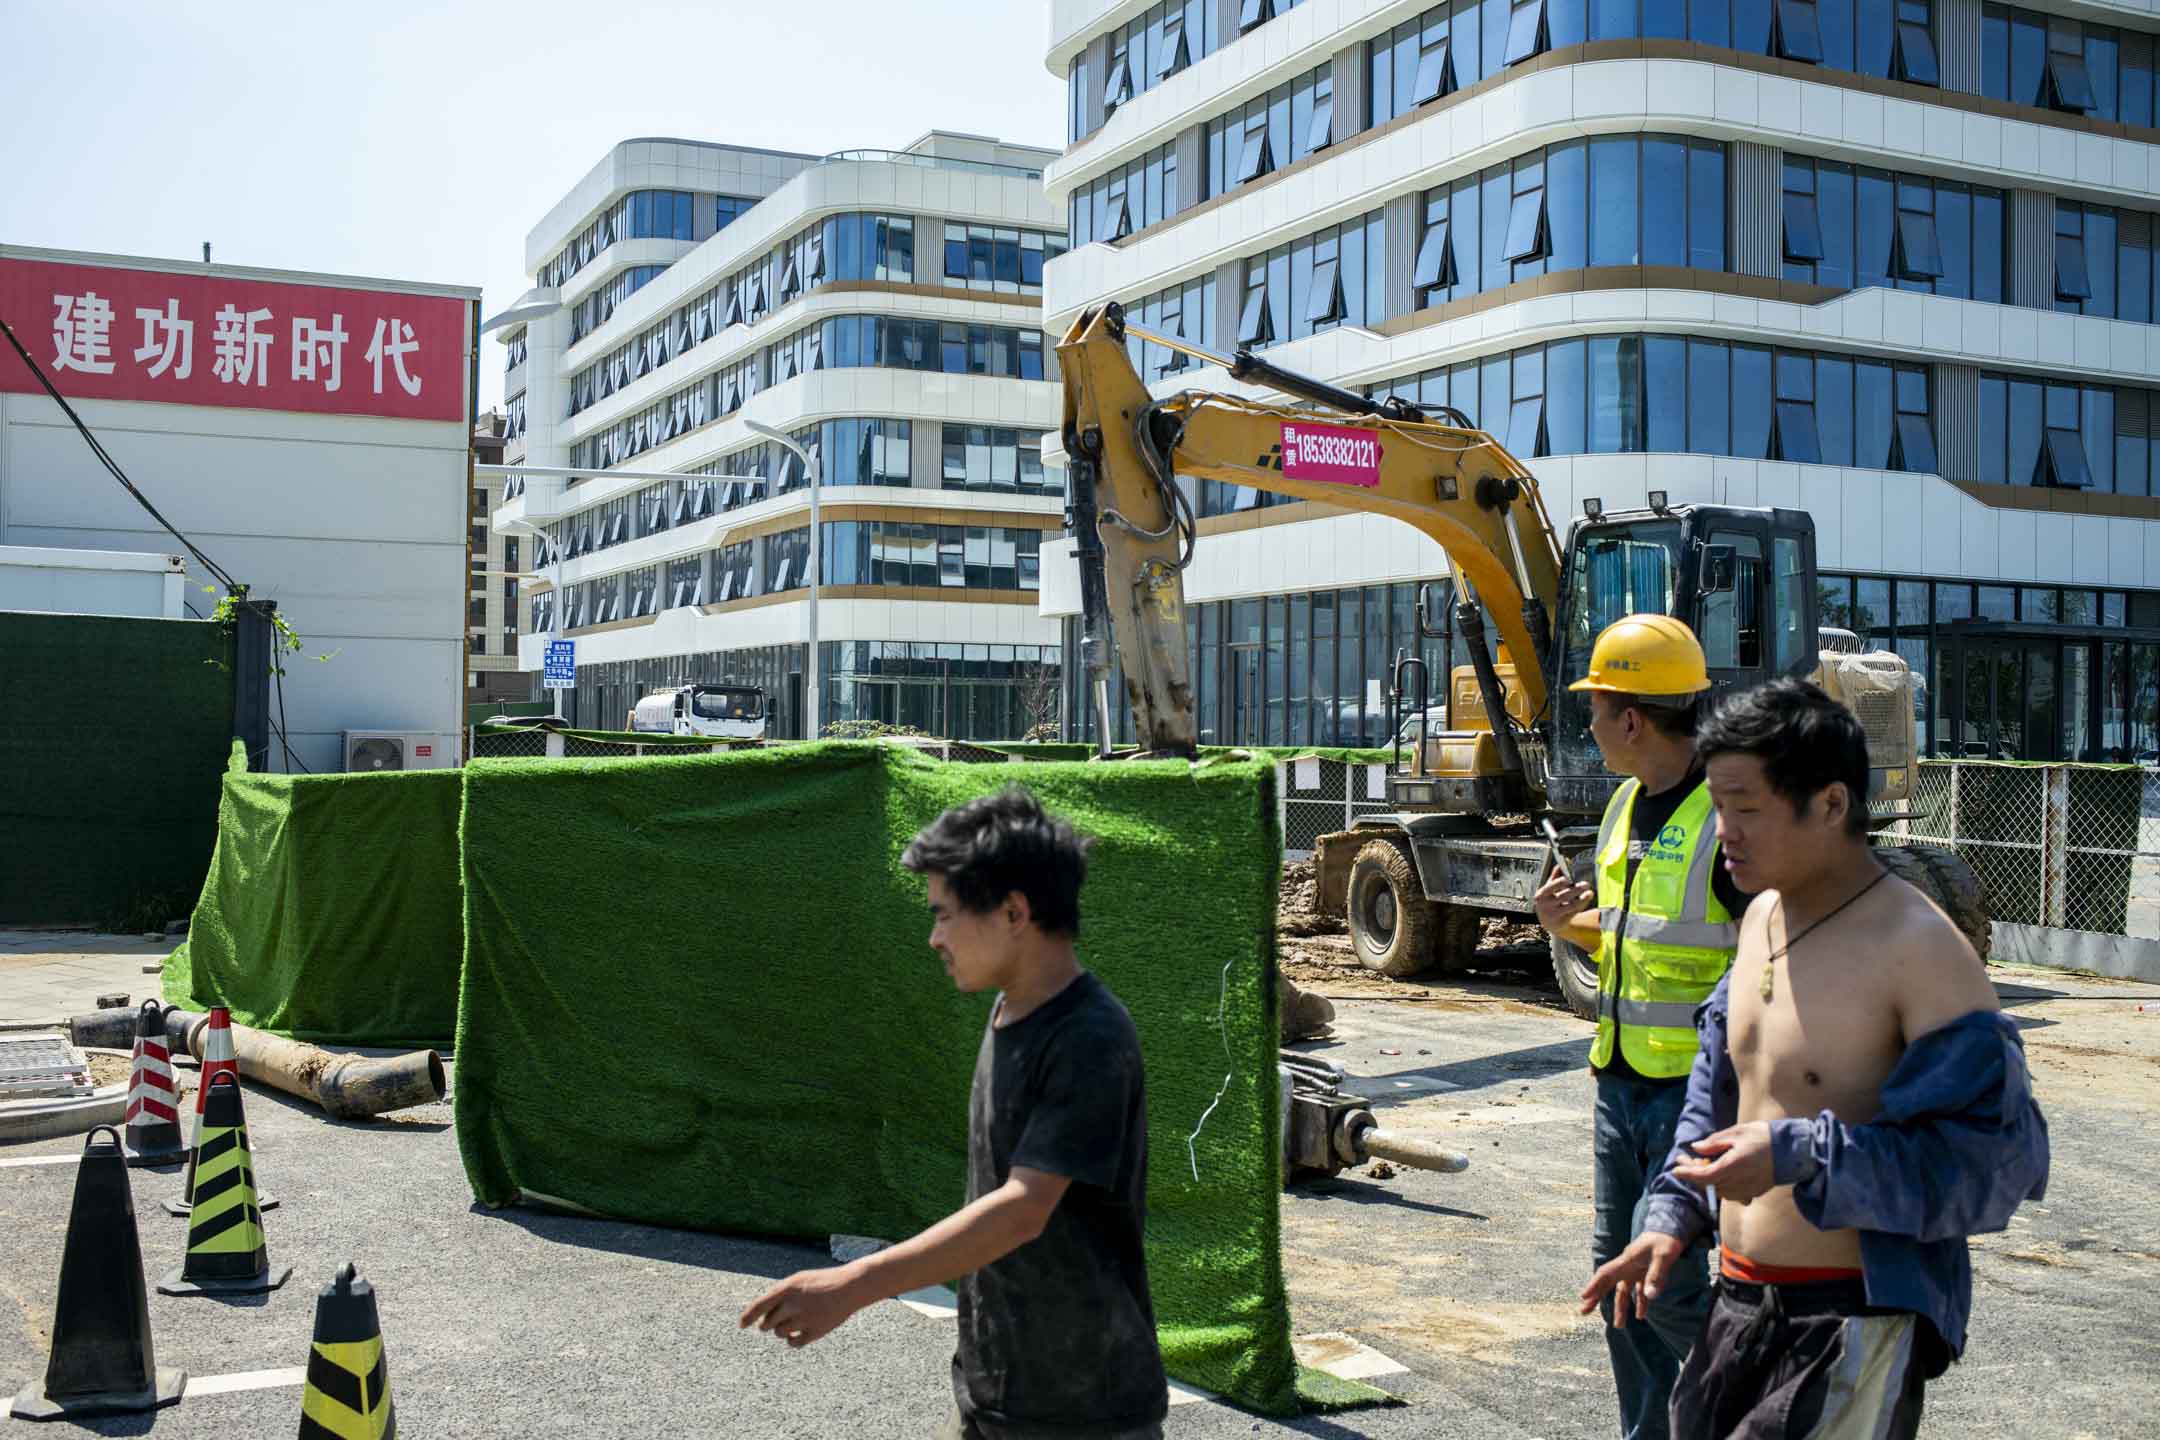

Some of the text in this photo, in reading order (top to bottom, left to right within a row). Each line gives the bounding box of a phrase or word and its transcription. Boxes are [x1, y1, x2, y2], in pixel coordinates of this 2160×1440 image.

[51, 291, 422, 396] 建功新时代
[1284, 427, 1297, 466] 租赁
[1296, 434, 1376, 468] 18538382121
